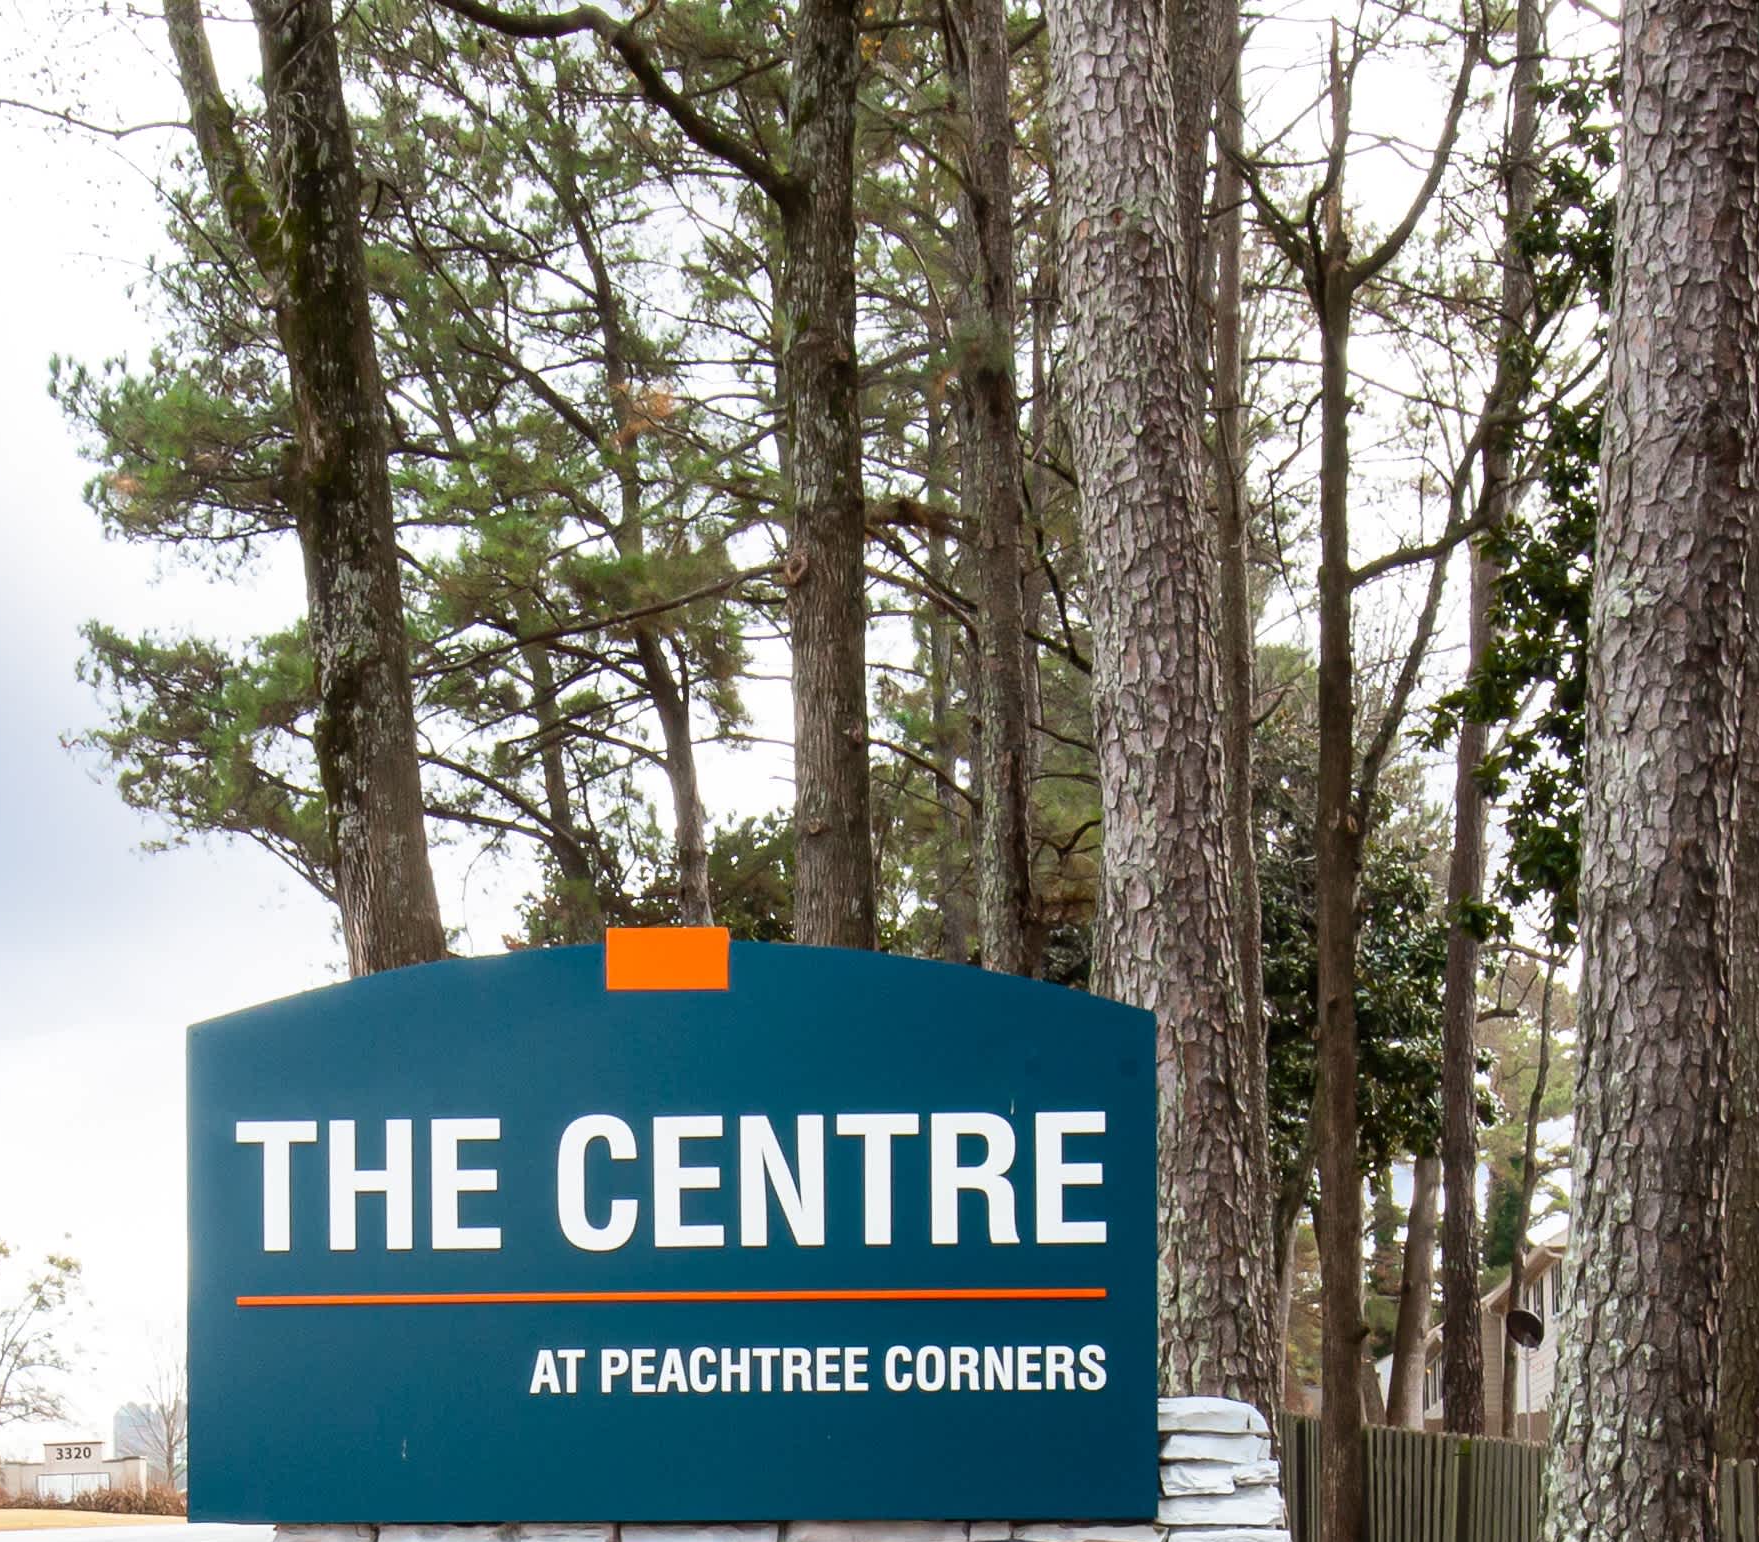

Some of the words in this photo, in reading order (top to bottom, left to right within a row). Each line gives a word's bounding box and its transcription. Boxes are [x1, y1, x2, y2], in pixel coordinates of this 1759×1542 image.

[235, 1118, 503, 1252] THE
[557, 1111, 1108, 1251] CENTRE
[529, 1349, 586, 1394] AT
[601, 1346, 869, 1393] PEACHTREE
[885, 1344, 1107, 1392] CORNERS
[56, 1446, 91, 1460] 3320
